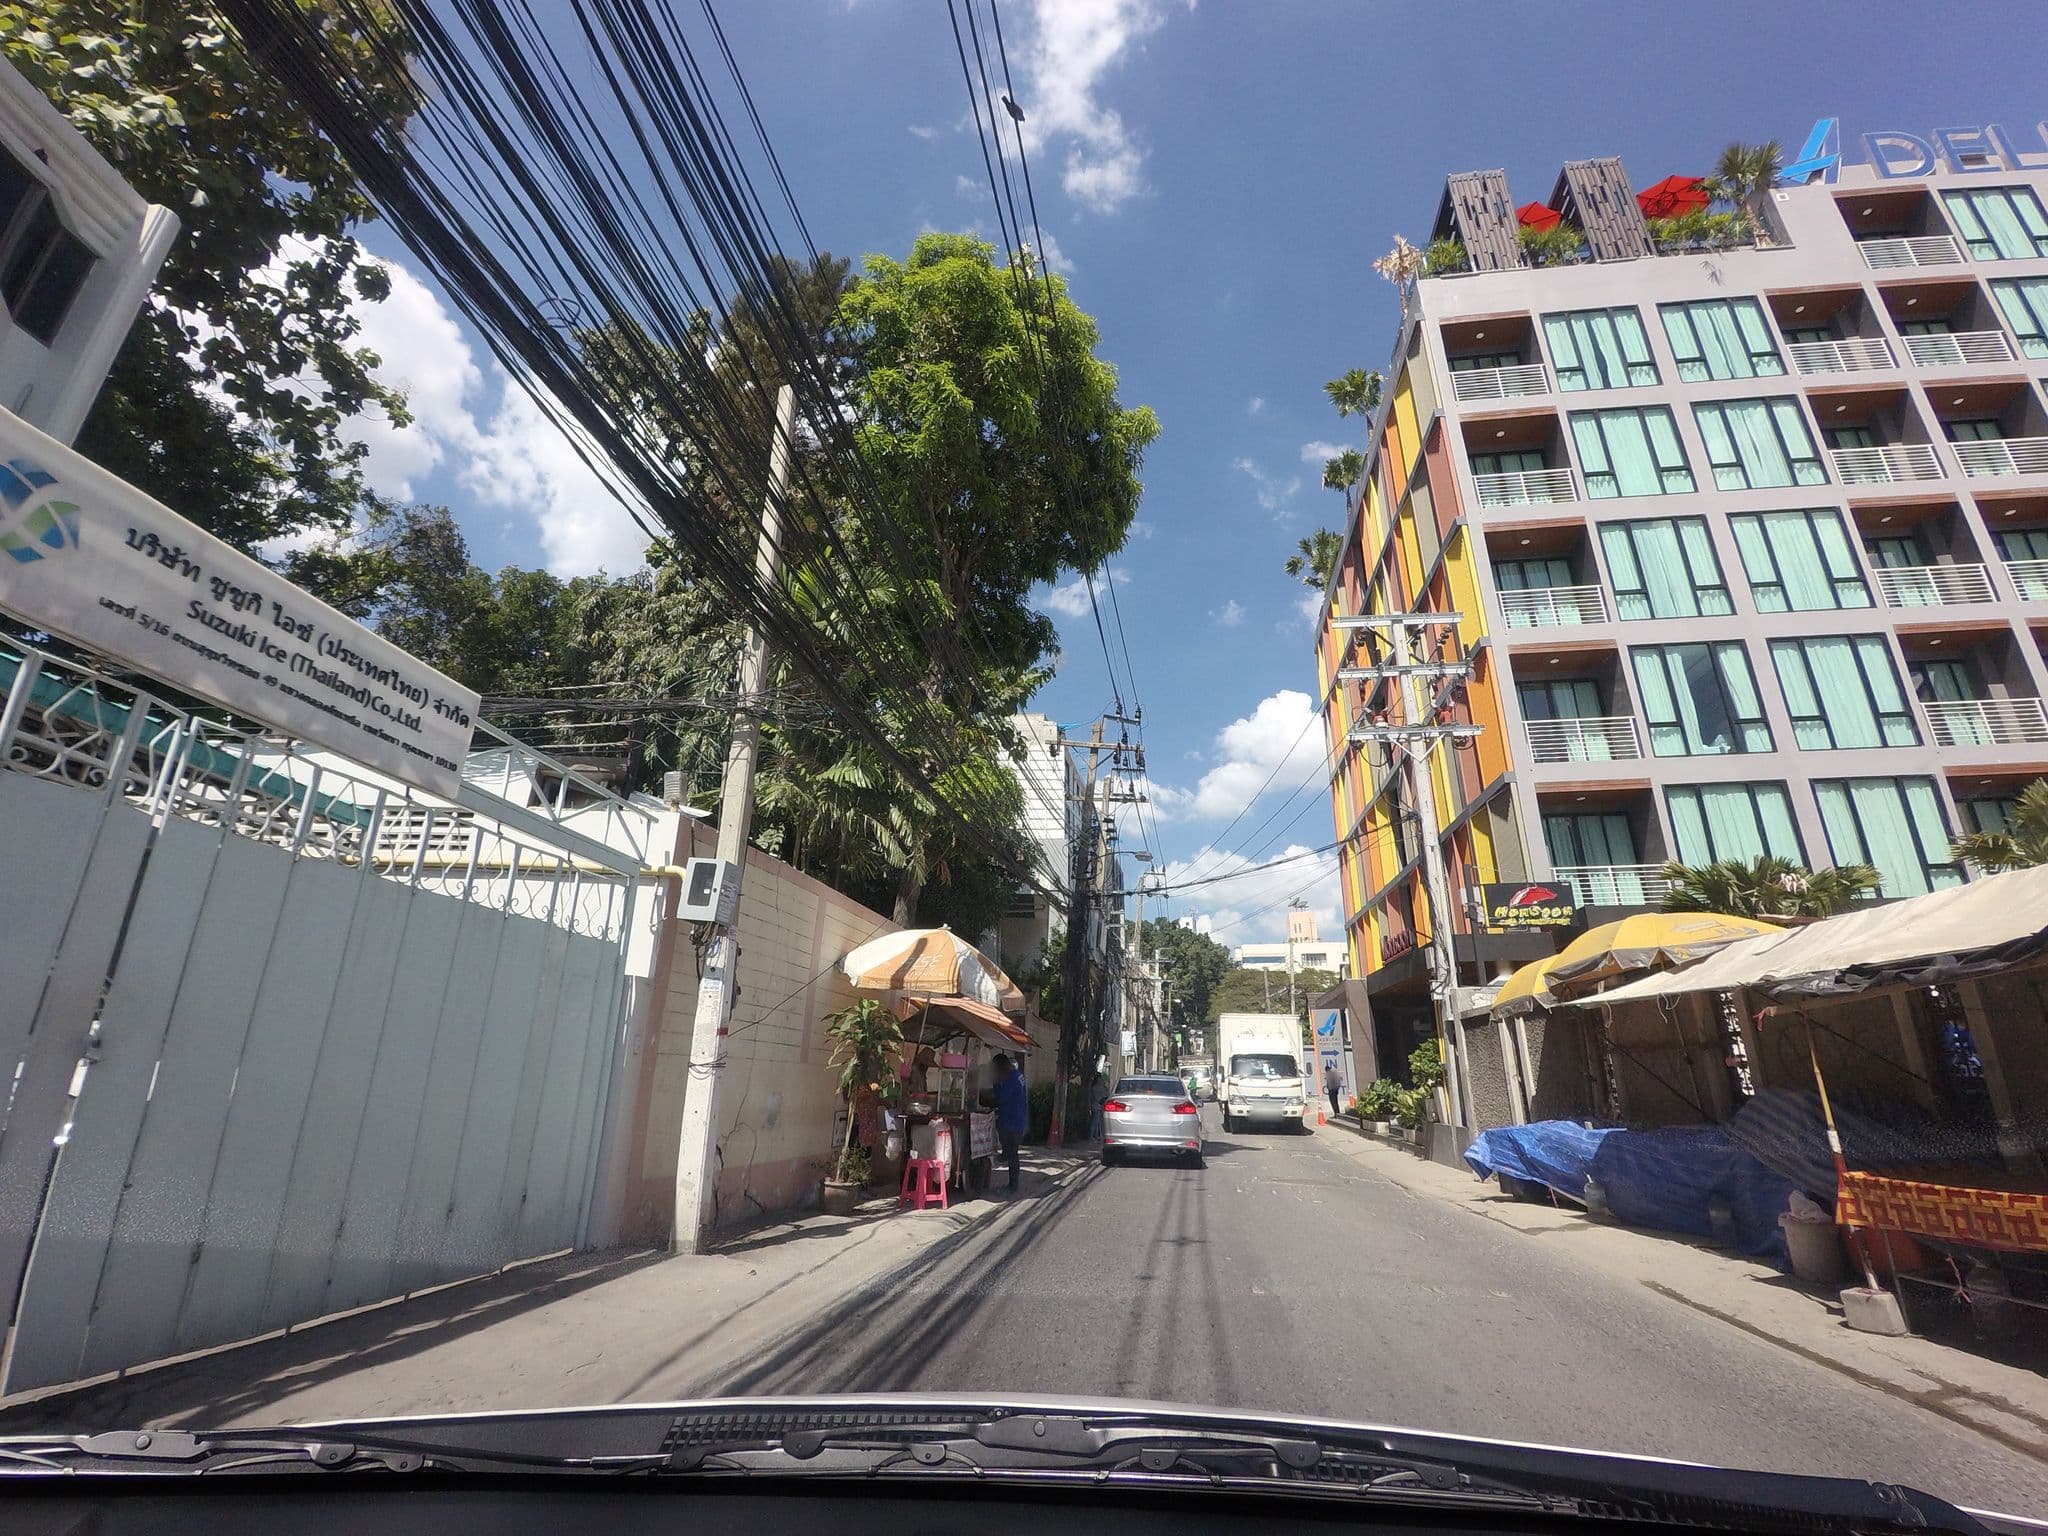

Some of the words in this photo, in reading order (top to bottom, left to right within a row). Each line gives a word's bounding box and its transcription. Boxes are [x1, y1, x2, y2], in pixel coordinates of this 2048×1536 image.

[125, 528, 201, 582] บริษัท
[317, 632, 429, 709] (ประเทศไทย)
[433, 697, 470, 729] จำกัด
[137, 613, 171, 637] 5/16
[186, 600, 258, 648] Suzuki
[259, 635, 287, 663] Ice
